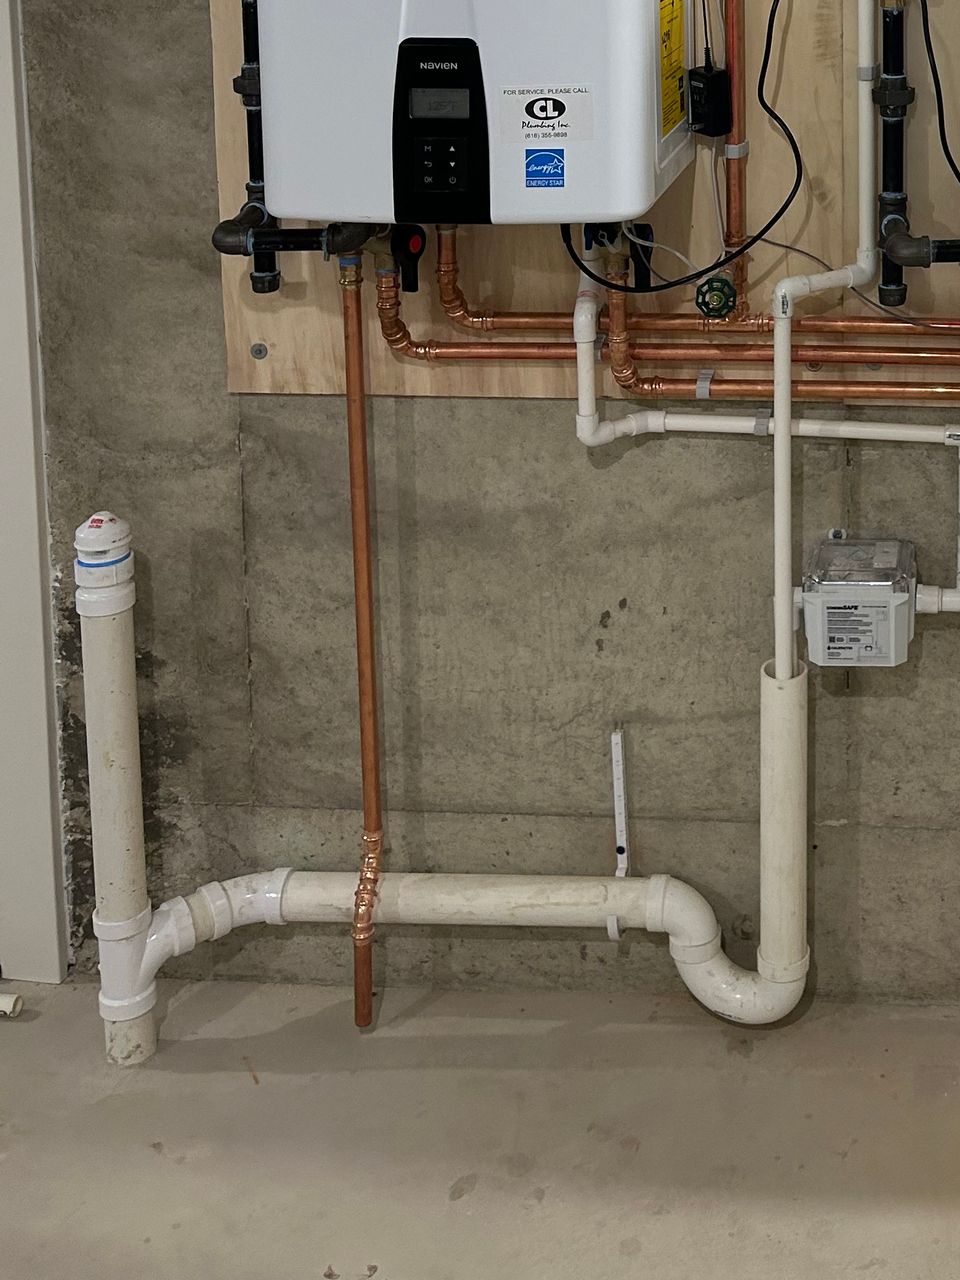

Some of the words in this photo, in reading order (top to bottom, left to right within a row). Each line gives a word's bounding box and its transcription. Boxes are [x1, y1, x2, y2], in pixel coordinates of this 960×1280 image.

[533, 100, 559, 118] CL
[521, 120, 556, 131] Plumbing
[424, 175, 433, 183] OK
